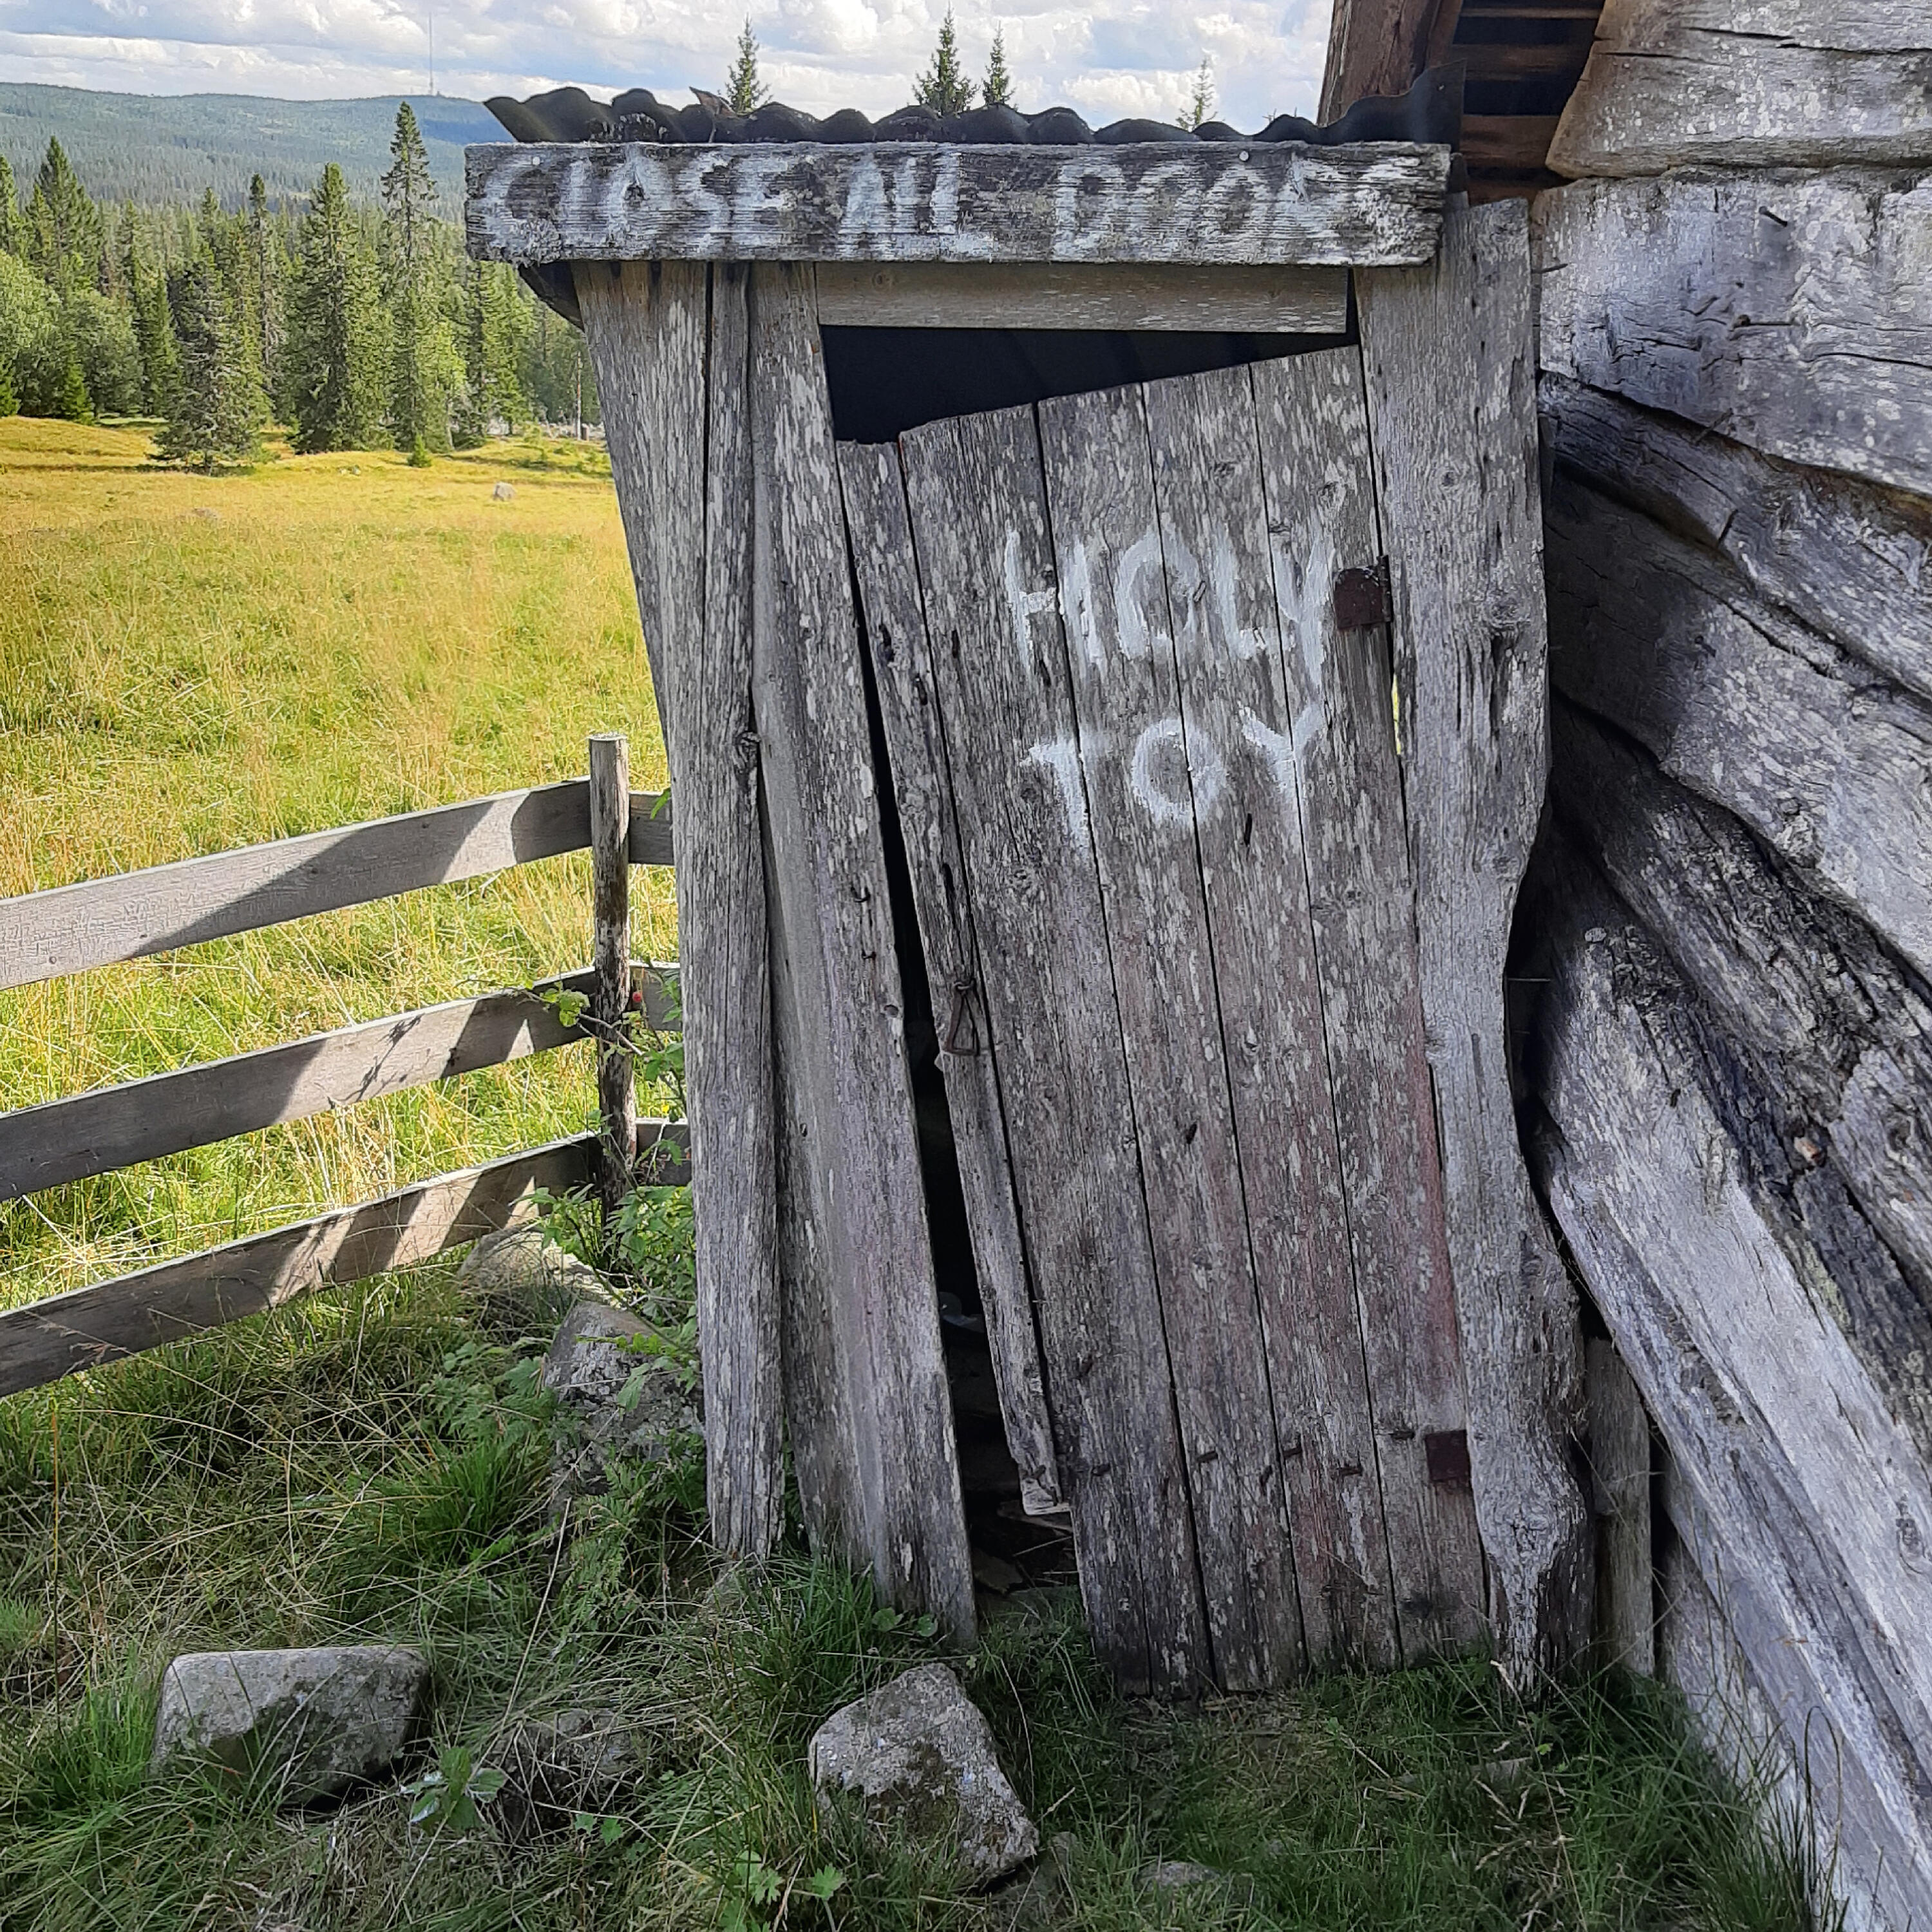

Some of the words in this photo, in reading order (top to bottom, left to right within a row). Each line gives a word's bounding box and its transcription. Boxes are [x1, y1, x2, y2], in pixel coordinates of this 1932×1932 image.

[837, 149, 998, 258] ALL
[1004, 515, 1333, 690] HOLY
[1023, 702, 1325, 857] TOY
